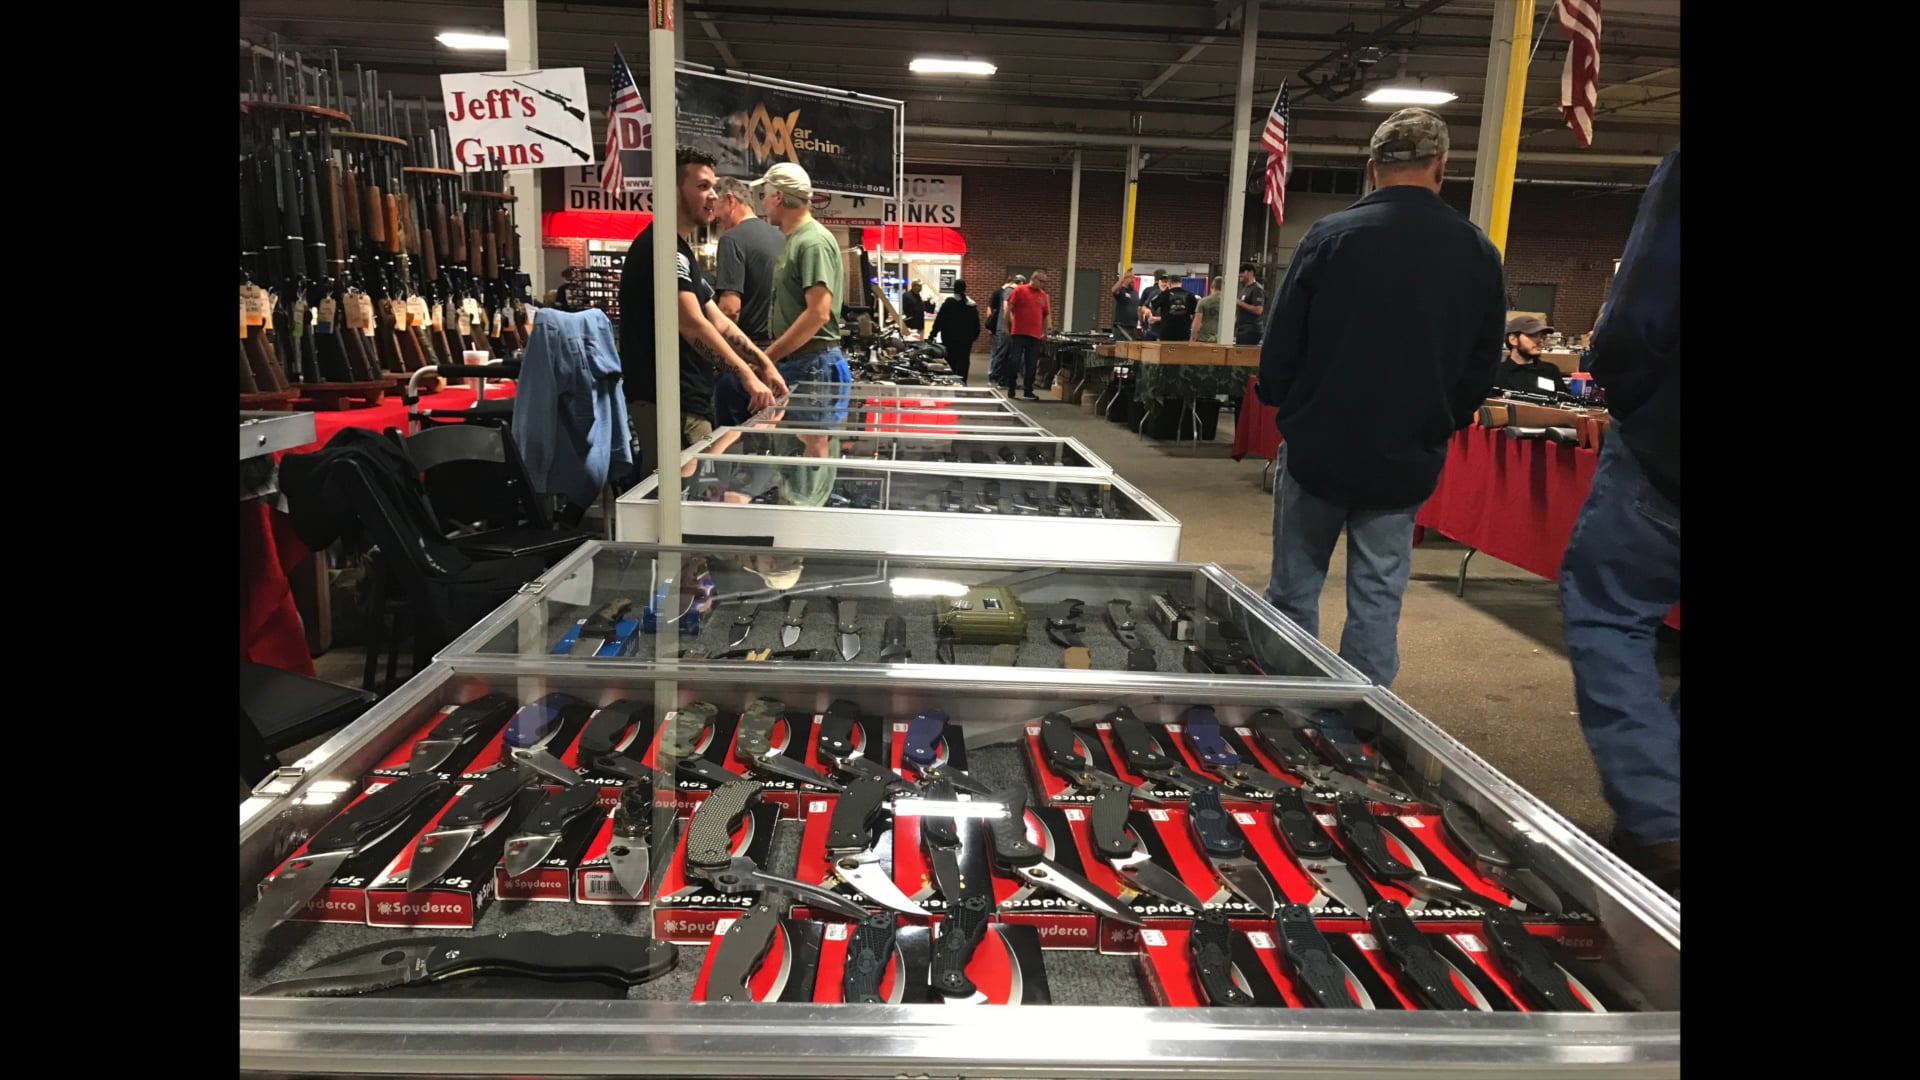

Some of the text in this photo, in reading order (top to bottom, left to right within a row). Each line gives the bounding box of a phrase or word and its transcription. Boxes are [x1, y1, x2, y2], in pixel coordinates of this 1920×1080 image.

[449, 88, 536, 121] Jeff's
[455, 138, 544, 168] Guns
[884, 203, 955, 224] RINKS
[515, 879, 562, 890] Spyderco
[304, 898, 356, 911] yderco
[393, 902, 463, 915] Spyderco
[1037, 924, 1088, 938] yderco
